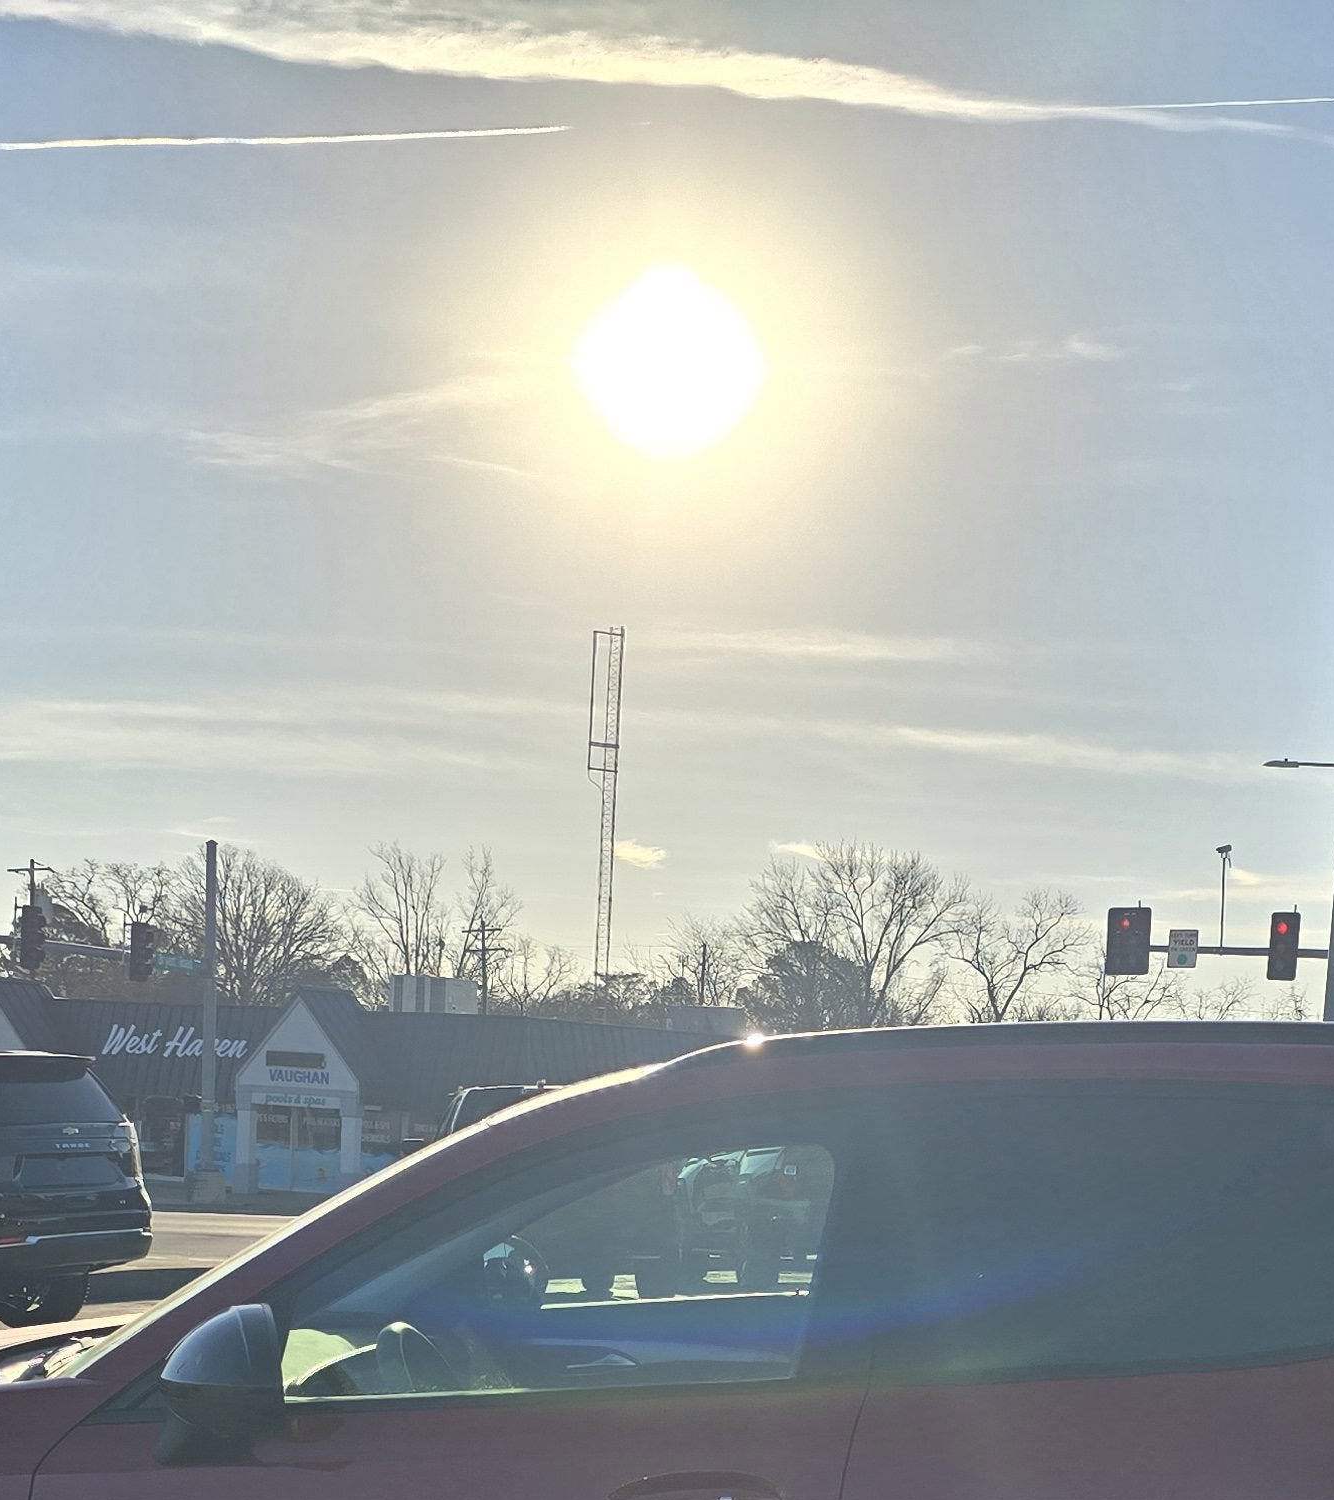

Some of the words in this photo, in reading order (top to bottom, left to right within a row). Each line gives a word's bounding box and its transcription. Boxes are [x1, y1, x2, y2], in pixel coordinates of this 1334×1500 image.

[101, 1023, 163, 1055] West
[163, 1026, 248, 1059] Haen
[269, 1069, 329, 1085] VAUGHAN
